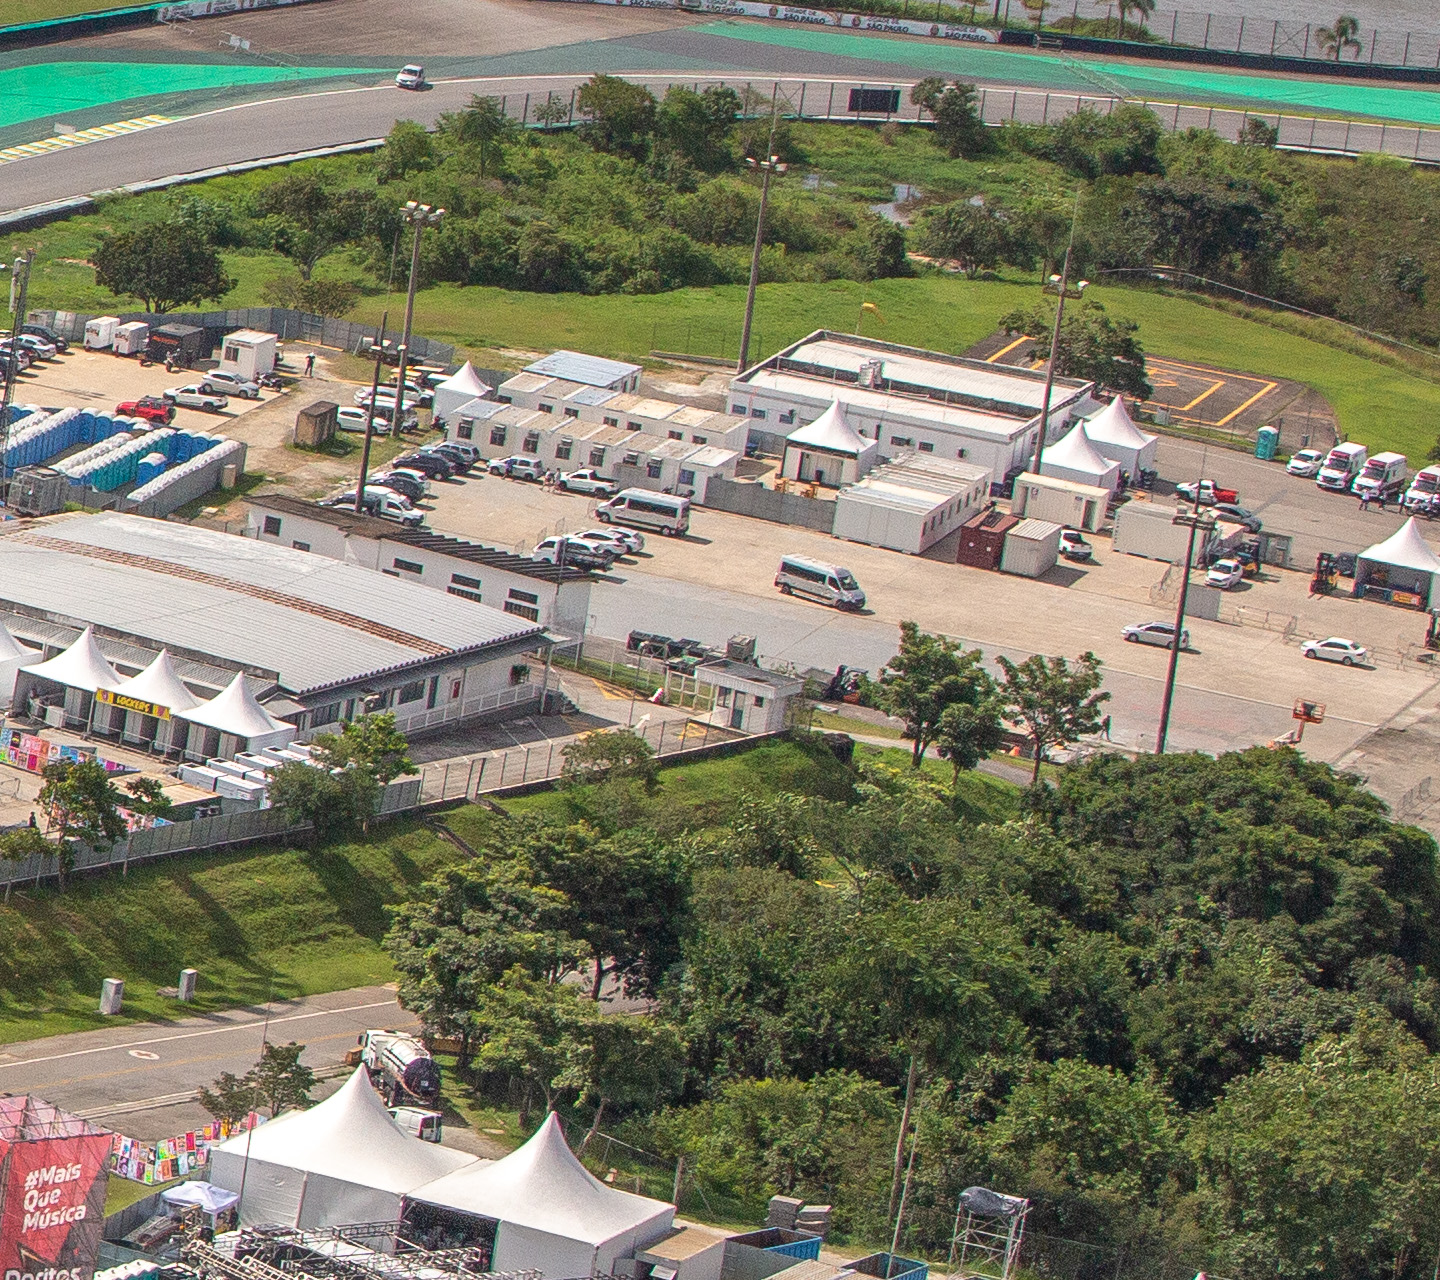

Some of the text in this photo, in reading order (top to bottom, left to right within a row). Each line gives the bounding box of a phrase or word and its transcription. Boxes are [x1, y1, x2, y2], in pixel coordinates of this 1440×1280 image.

[117, 696, 151, 712] LOCKERS
[25, 1163, 82, 1191] #Mais
[24, 1188, 61, 1212] Que
[22, 1205, 86, 1233] Música
